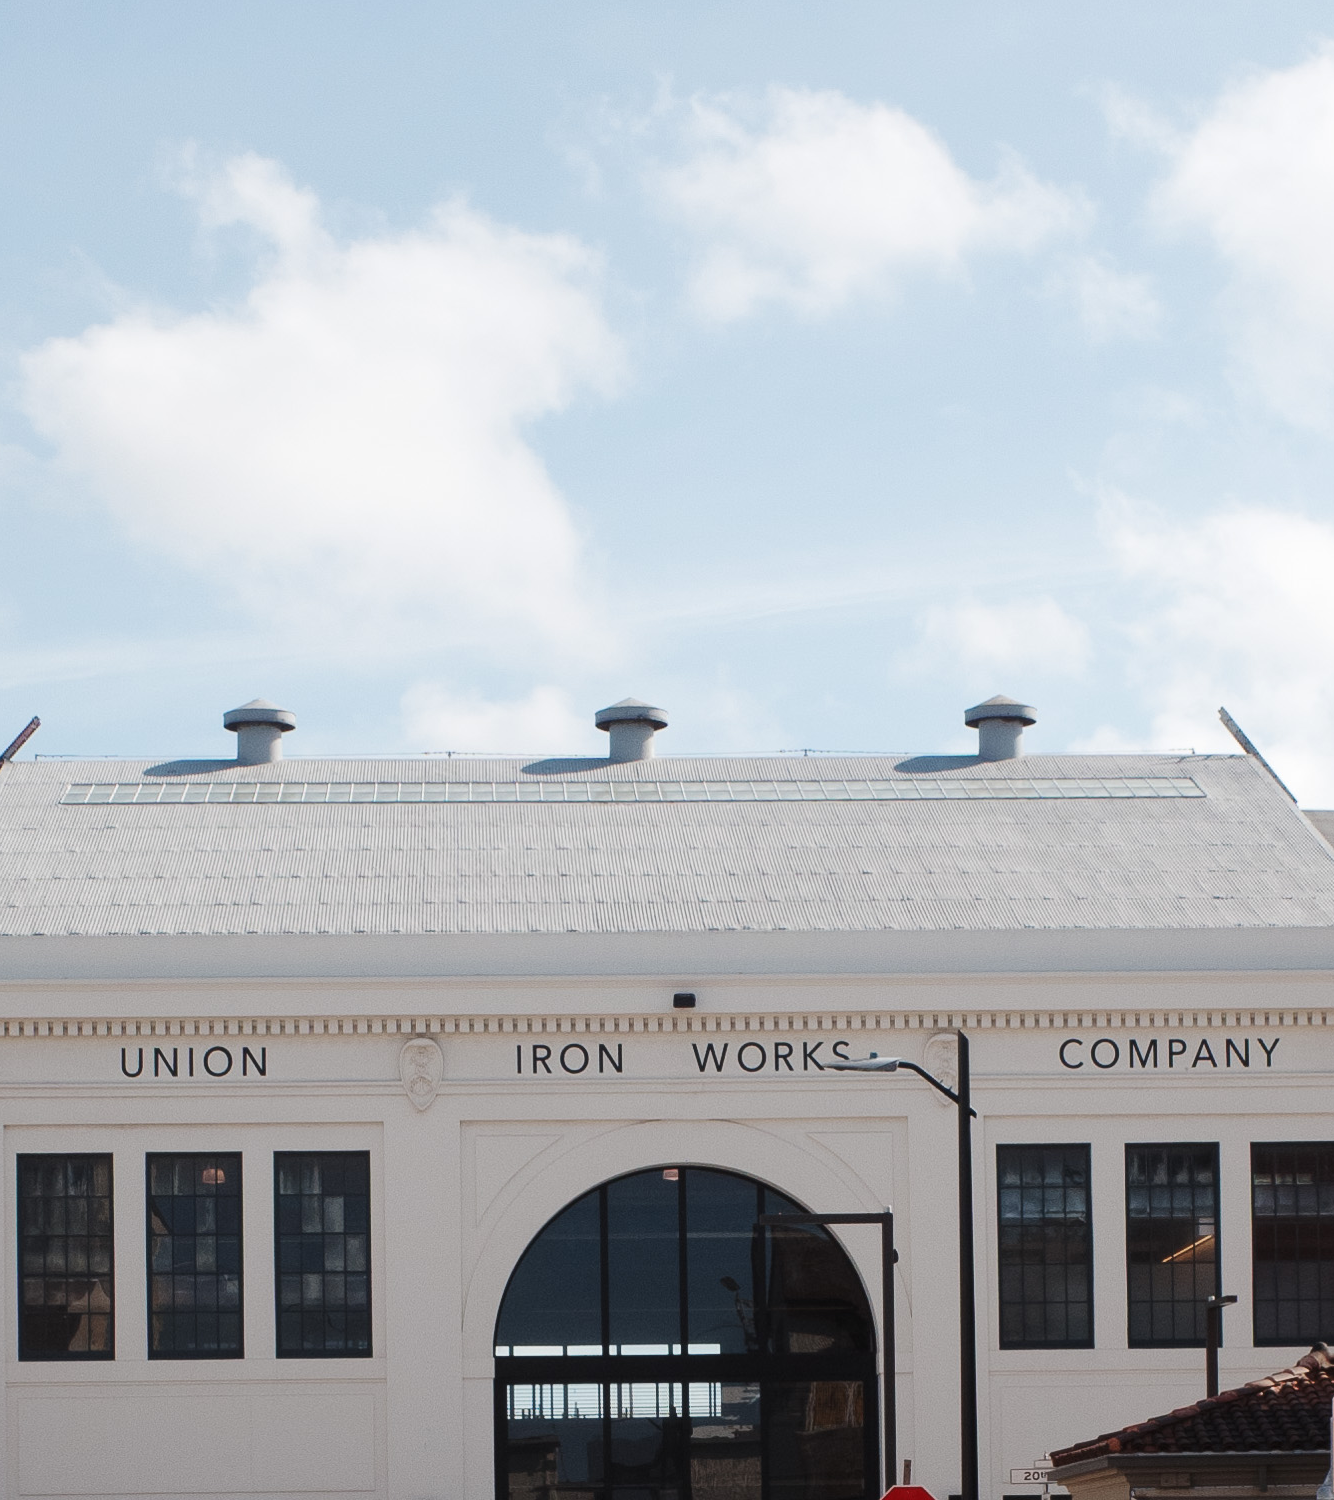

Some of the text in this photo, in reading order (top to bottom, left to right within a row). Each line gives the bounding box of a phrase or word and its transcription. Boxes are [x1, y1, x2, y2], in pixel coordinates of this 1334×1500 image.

[120, 1037, 1281, 1077] UNION IRON WORKS COMPANY
